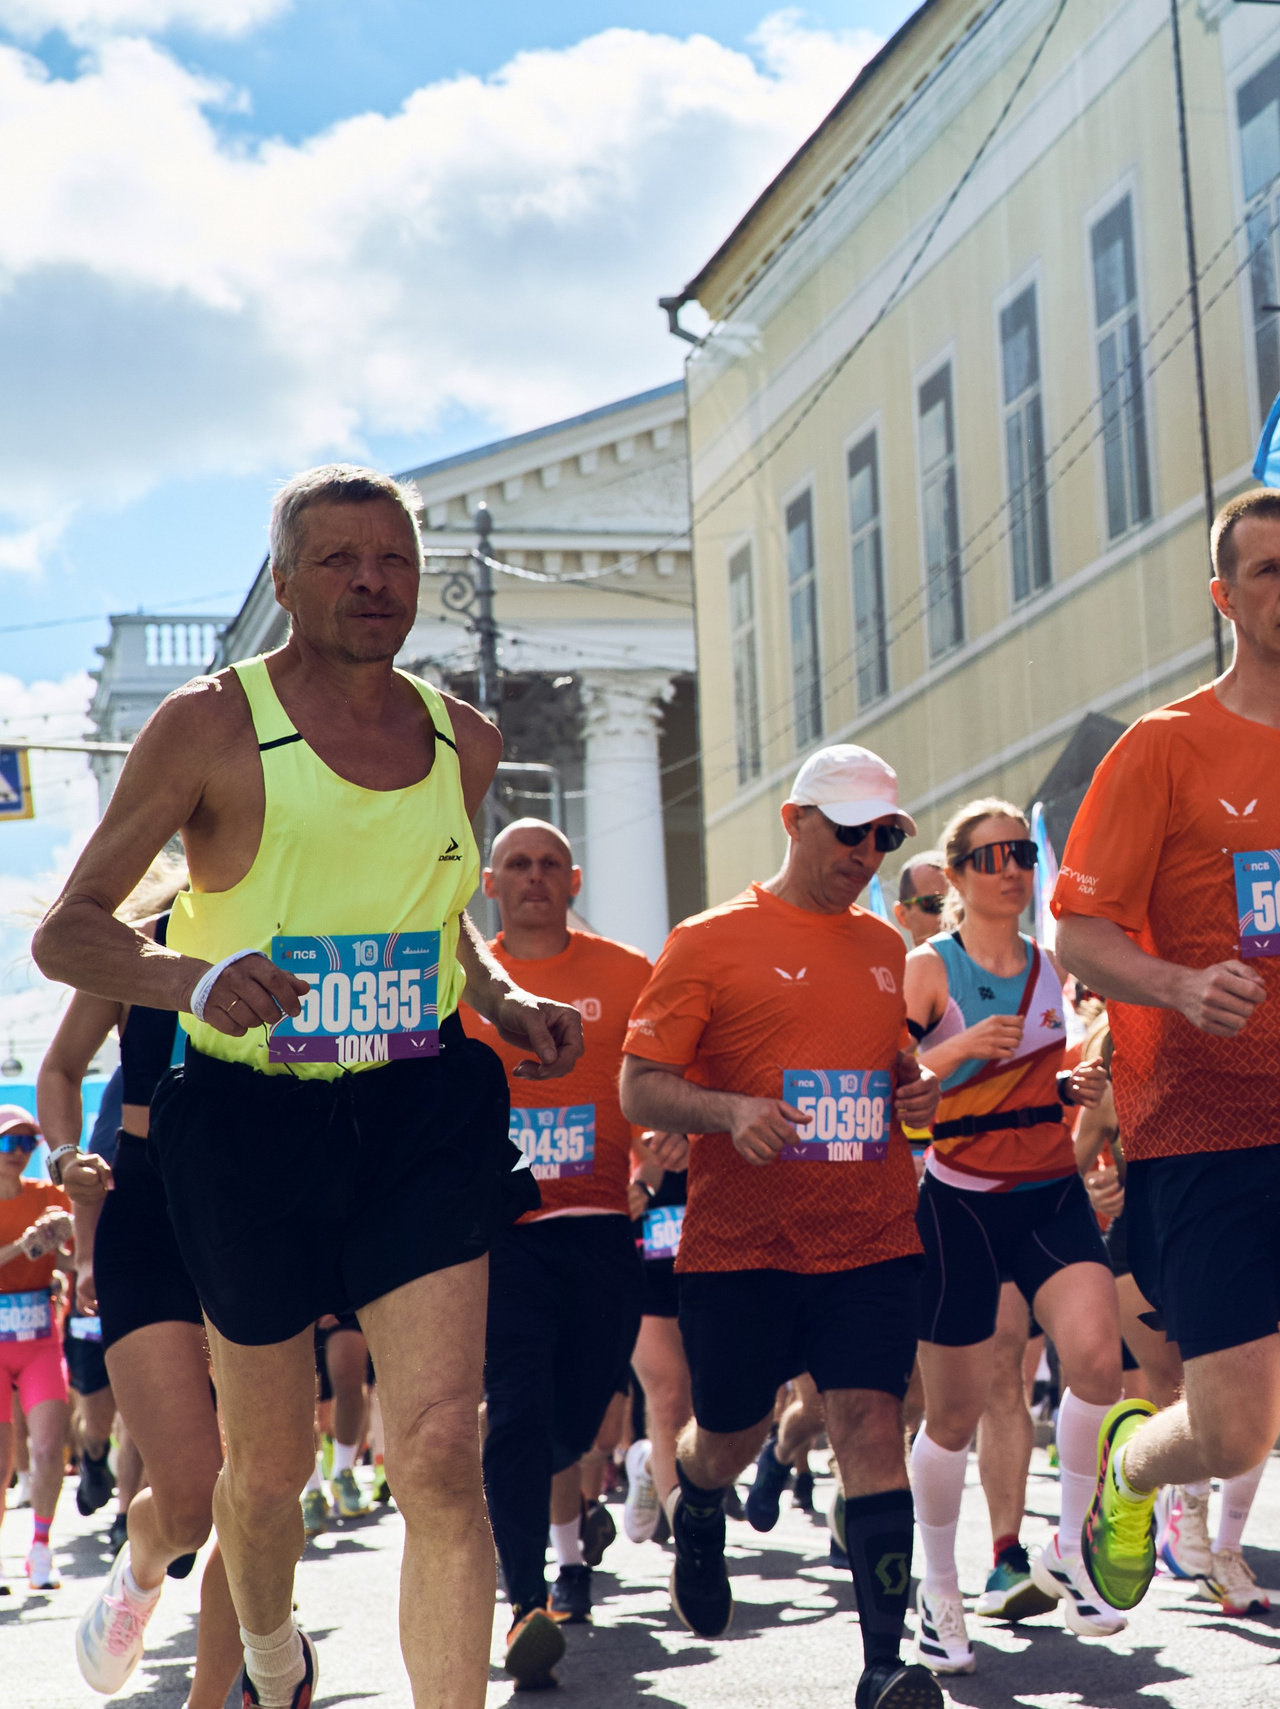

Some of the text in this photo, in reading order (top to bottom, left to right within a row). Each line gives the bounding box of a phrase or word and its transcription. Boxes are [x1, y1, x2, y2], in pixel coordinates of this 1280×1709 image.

[1251, 862, 1270, 871] ПСБ
[293, 950, 316, 960] ПСБ
[352, 940, 379, 967] 10
[870, 966, 897, 994] 10
[292, 969, 421, 1033] 50355
[335, 1034, 389, 1062] 10KM
[839, 1074, 858, 1093] 10
[796, 1096, 884, 1141] 50398
[827, 1142, 863, 1161] 10KM
